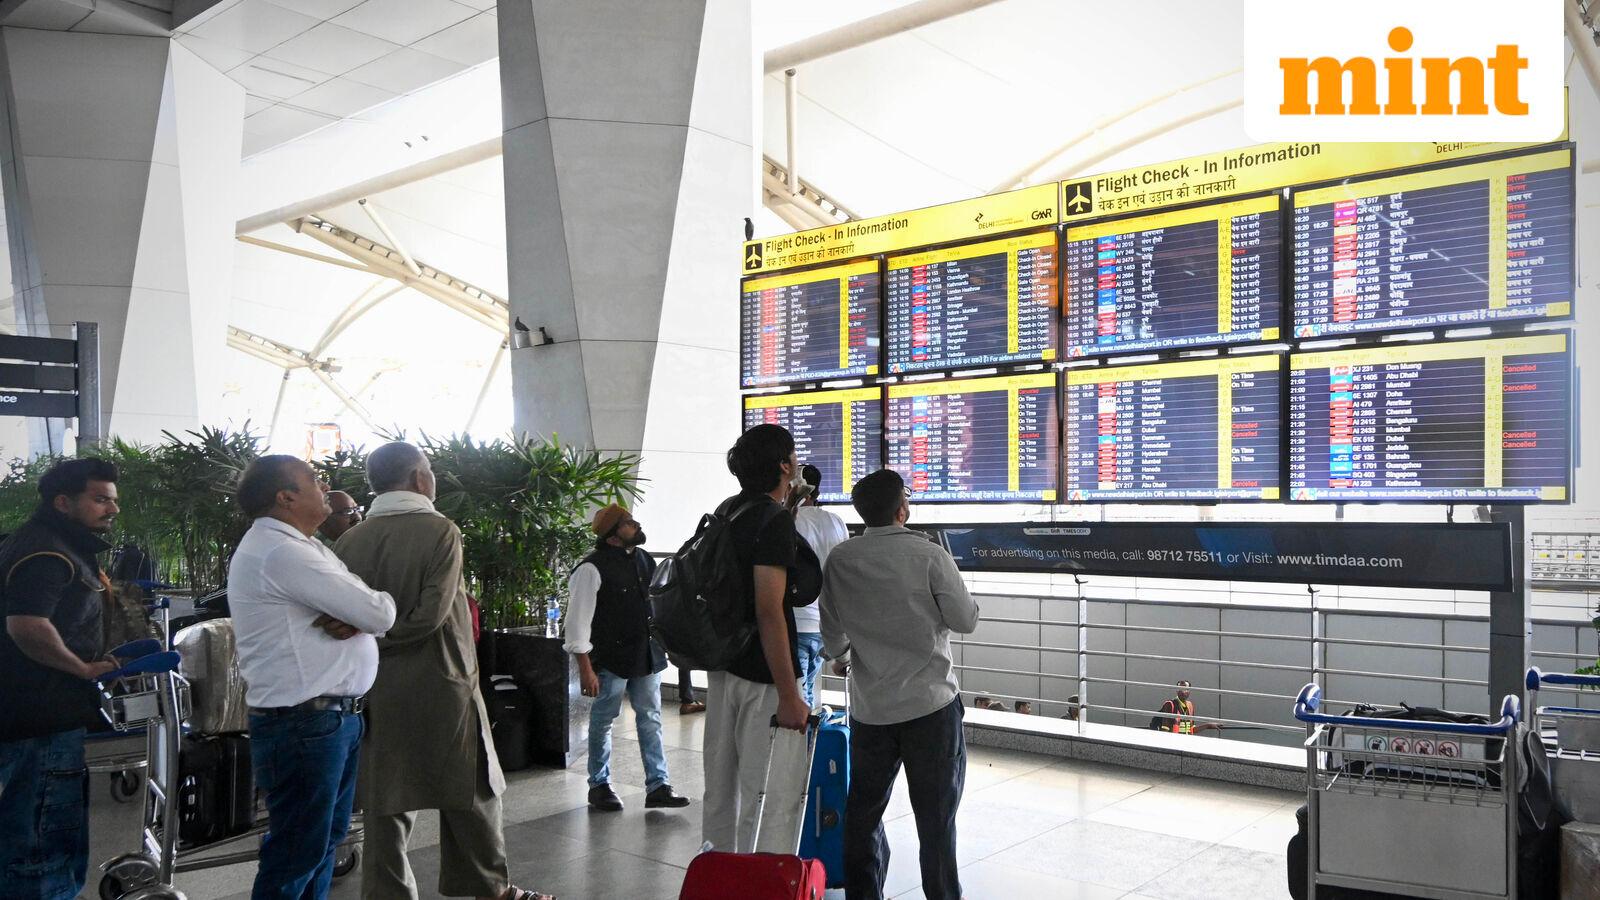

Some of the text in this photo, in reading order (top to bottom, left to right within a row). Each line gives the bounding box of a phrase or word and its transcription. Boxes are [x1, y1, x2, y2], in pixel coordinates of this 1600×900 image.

[1436, 142, 1463, 154] DELHI
[1096, 173, 1138, 193] Flight
[1142, 164, 1190, 184] Check
[1203, 160, 1218, 175] In
[1223, 142, 1321, 171] Information
[1097, 174, 1236, 211] चेक इन एवं उड़ान की जानकारी
[765, 238, 793, 254] Flight
[794, 231, 826, 248] Check
[834, 228, 844, 241] In
[846, 216, 909, 238] Information
[815, 246, 826, 260] की
[827, 240, 855, 257] जानकारी
[972, 546, 1403, 568] For advertising on this media, call: 98712 75511 or Visit: www.timdaa.com
